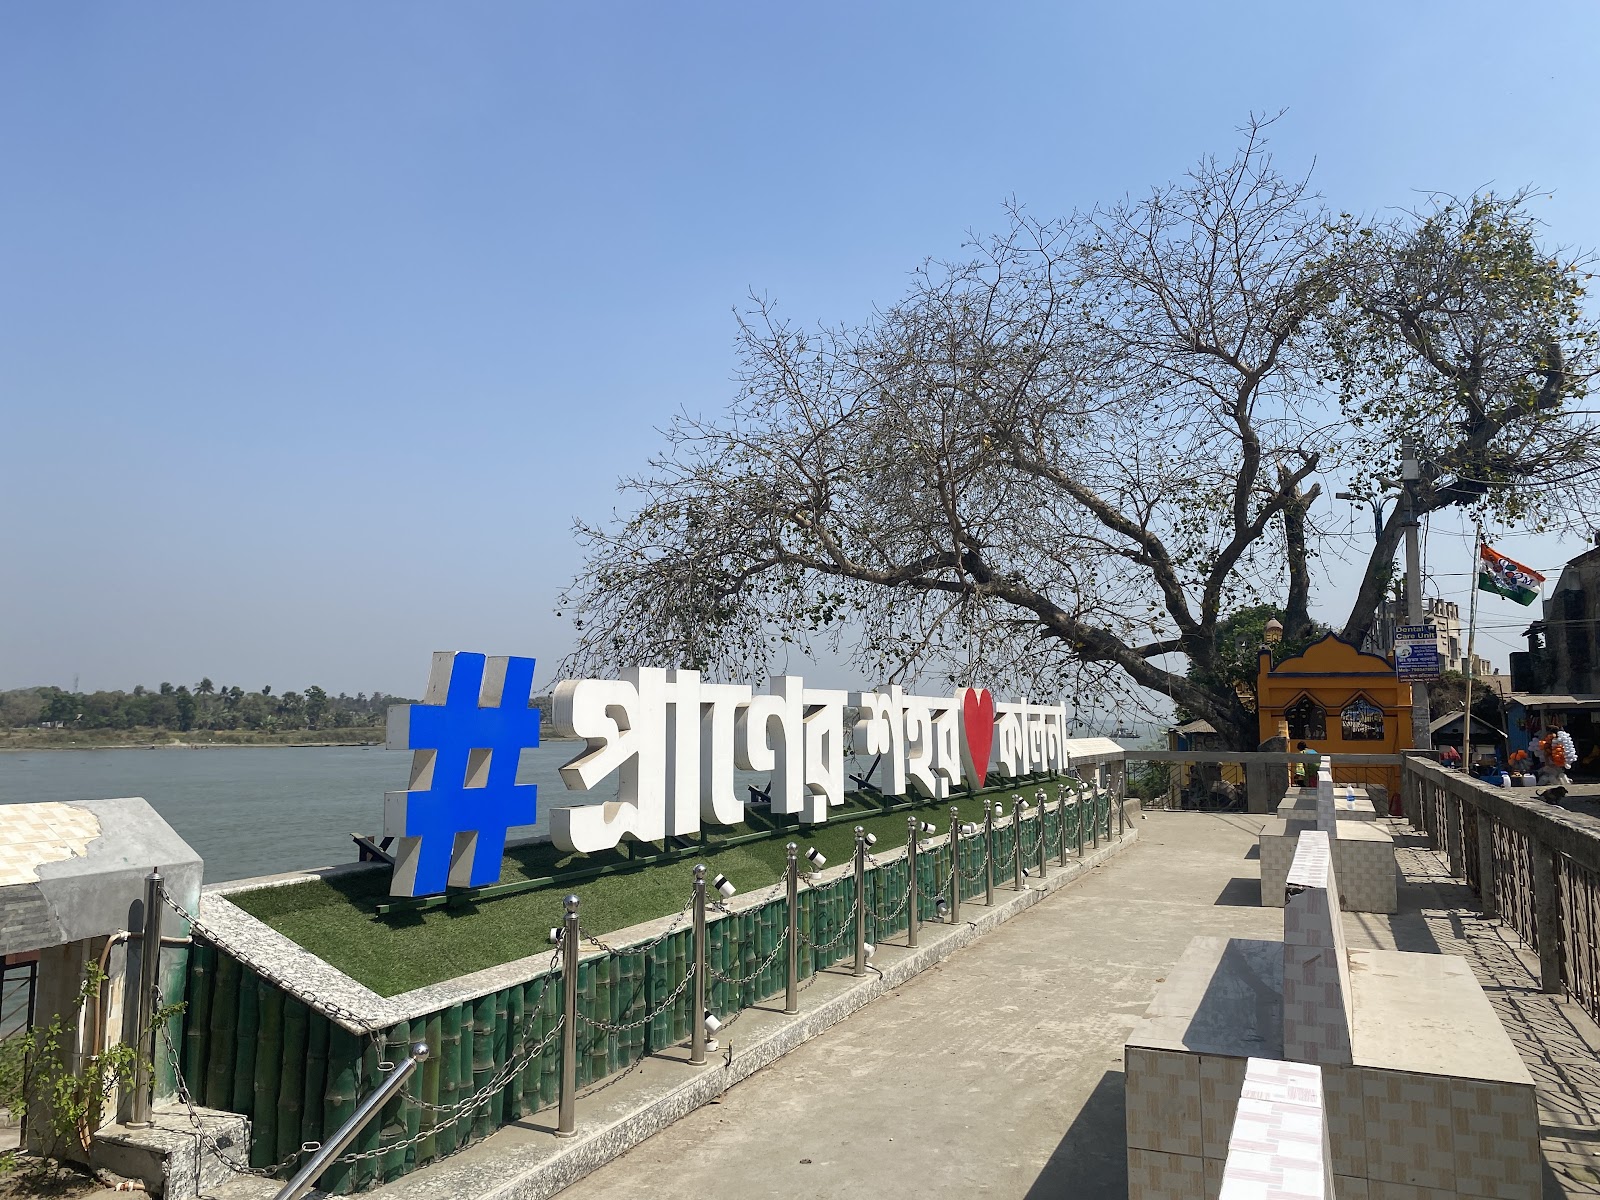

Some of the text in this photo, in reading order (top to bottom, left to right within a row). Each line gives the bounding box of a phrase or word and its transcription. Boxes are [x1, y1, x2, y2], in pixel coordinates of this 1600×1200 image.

[550, 666, 848, 854] প্রাণের
[853, 684, 962, 799] শহর
[994, 696, 1069, 778] কালনা
